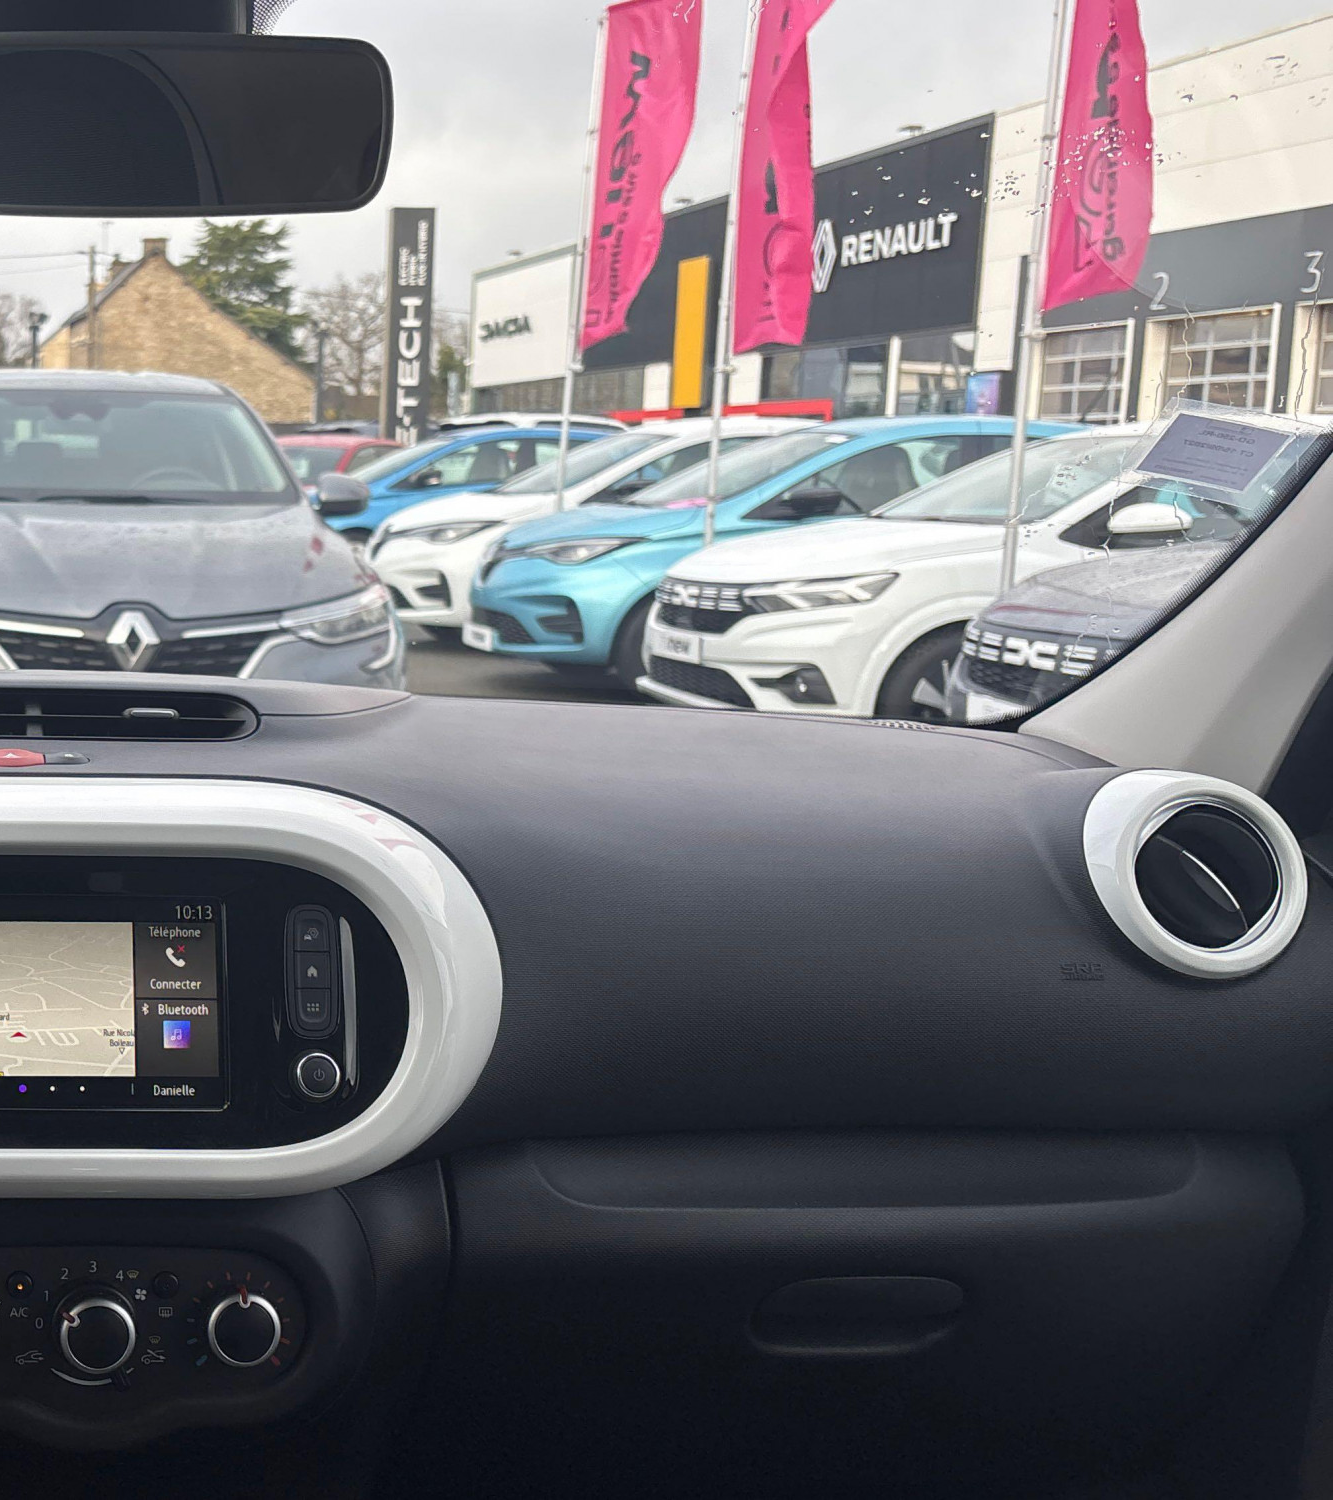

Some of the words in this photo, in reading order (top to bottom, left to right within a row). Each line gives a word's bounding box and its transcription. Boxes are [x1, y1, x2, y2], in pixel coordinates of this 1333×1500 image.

[841, 212, 958, 267] RENAULT
[1299, 251, 1324, 293] 3
[1149, 272, 1169, 310] 2
[175, 905, 213, 920] 10:13
[148, 926, 201, 940] Téléphone
[150, 978, 202, 990] Connecter
[157, 1003, 209, 1016] Bluetooth
[103, 1029, 115, 1037] Rue
[109, 1039, 135, 1047] Boileau
[153, 1084, 196, 1096] Danielle
[89, 1260, 97, 1273] 3
[61, 1268, 69, 1280] 2
[115, 1270, 124, 1281] 4
[43, 1290, 49, 1302] 1
[9, 1307, 28, 1318] A/C
[35, 1318, 44, 1329] 0
